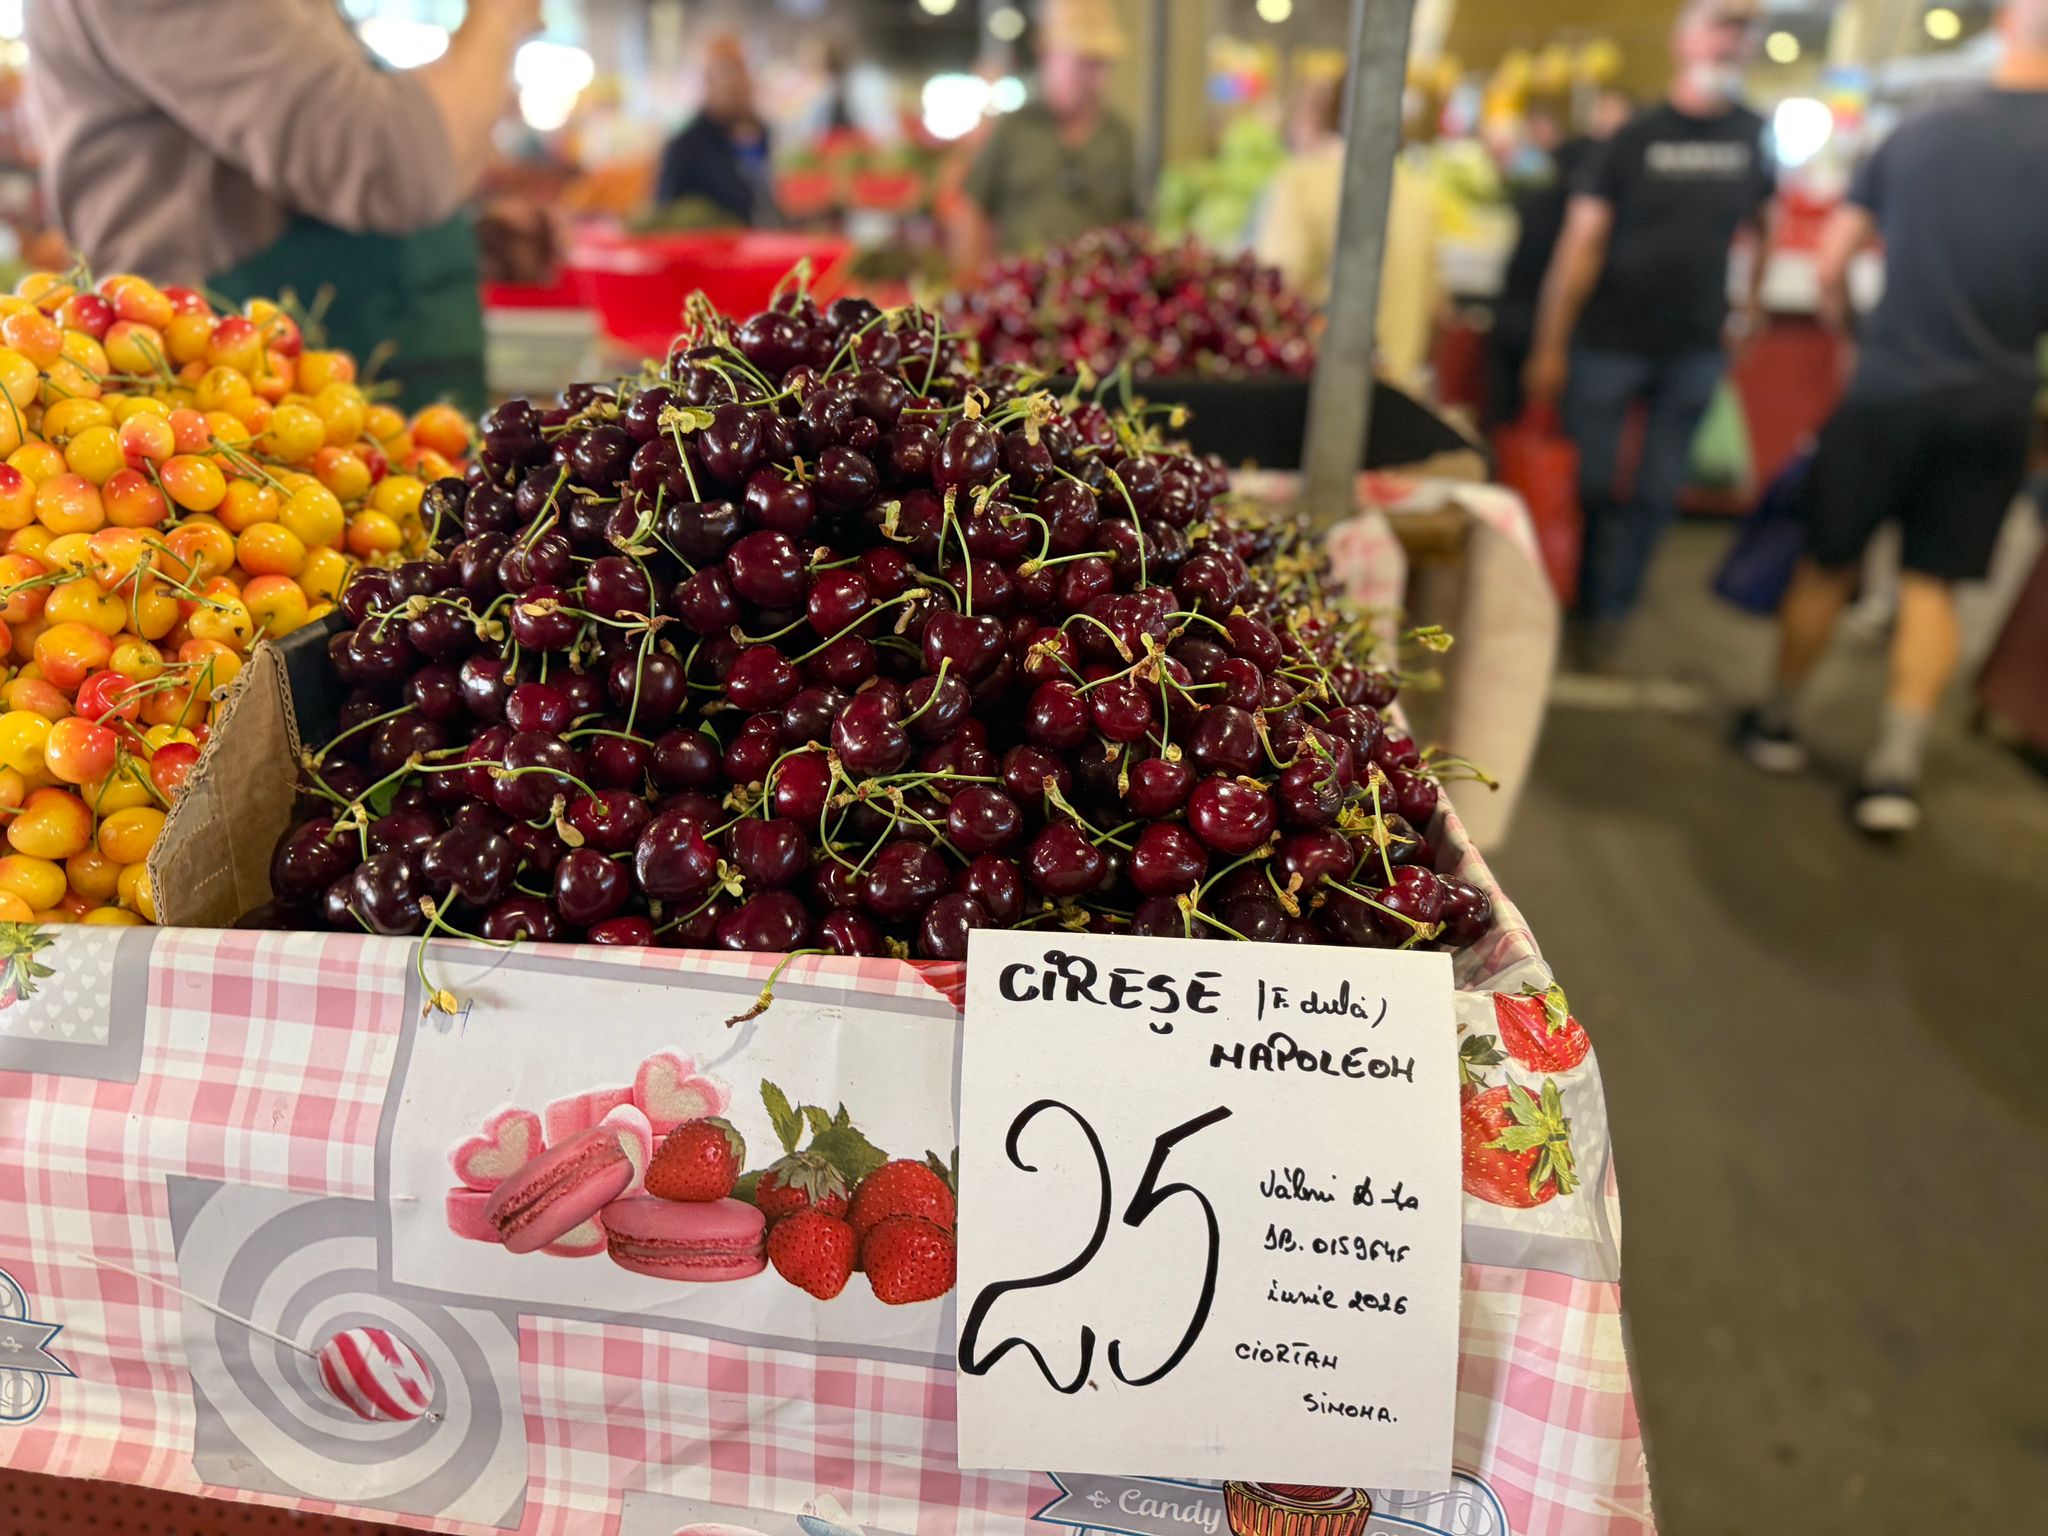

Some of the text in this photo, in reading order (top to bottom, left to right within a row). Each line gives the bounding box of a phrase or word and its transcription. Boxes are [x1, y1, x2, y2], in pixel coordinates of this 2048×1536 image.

[1208, 1031, 1416, 1083] NAPOLEON
[958, 1099, 1234, 1395] 25
[1266, 1278, 1409, 1316] iunie 2026
[1118, 1488, 1222, 1535] Candy
